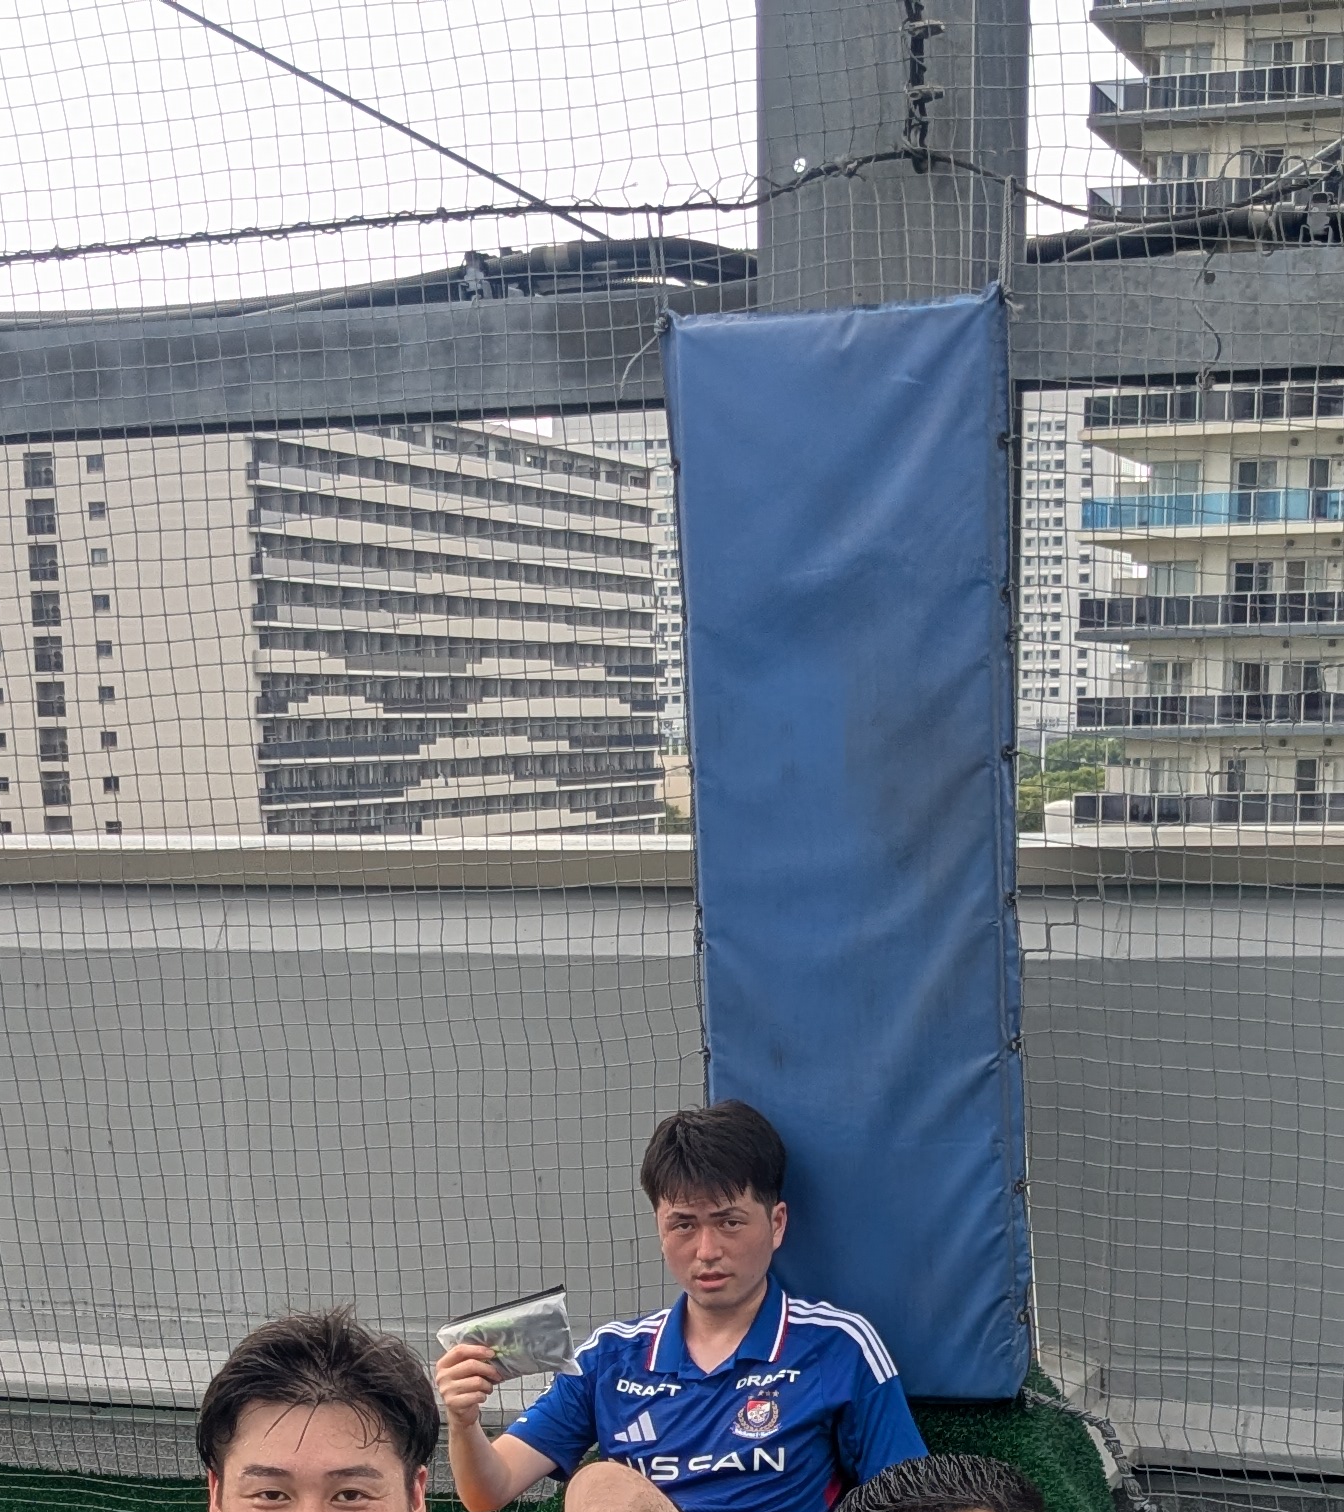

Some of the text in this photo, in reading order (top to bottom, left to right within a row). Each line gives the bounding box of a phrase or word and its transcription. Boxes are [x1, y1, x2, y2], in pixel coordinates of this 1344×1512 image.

[616, 1379, 682, 1397] DRAFT
[736, 1369, 801, 1389] DRAFT
[608, 1447, 785, 1481] ISSAN
